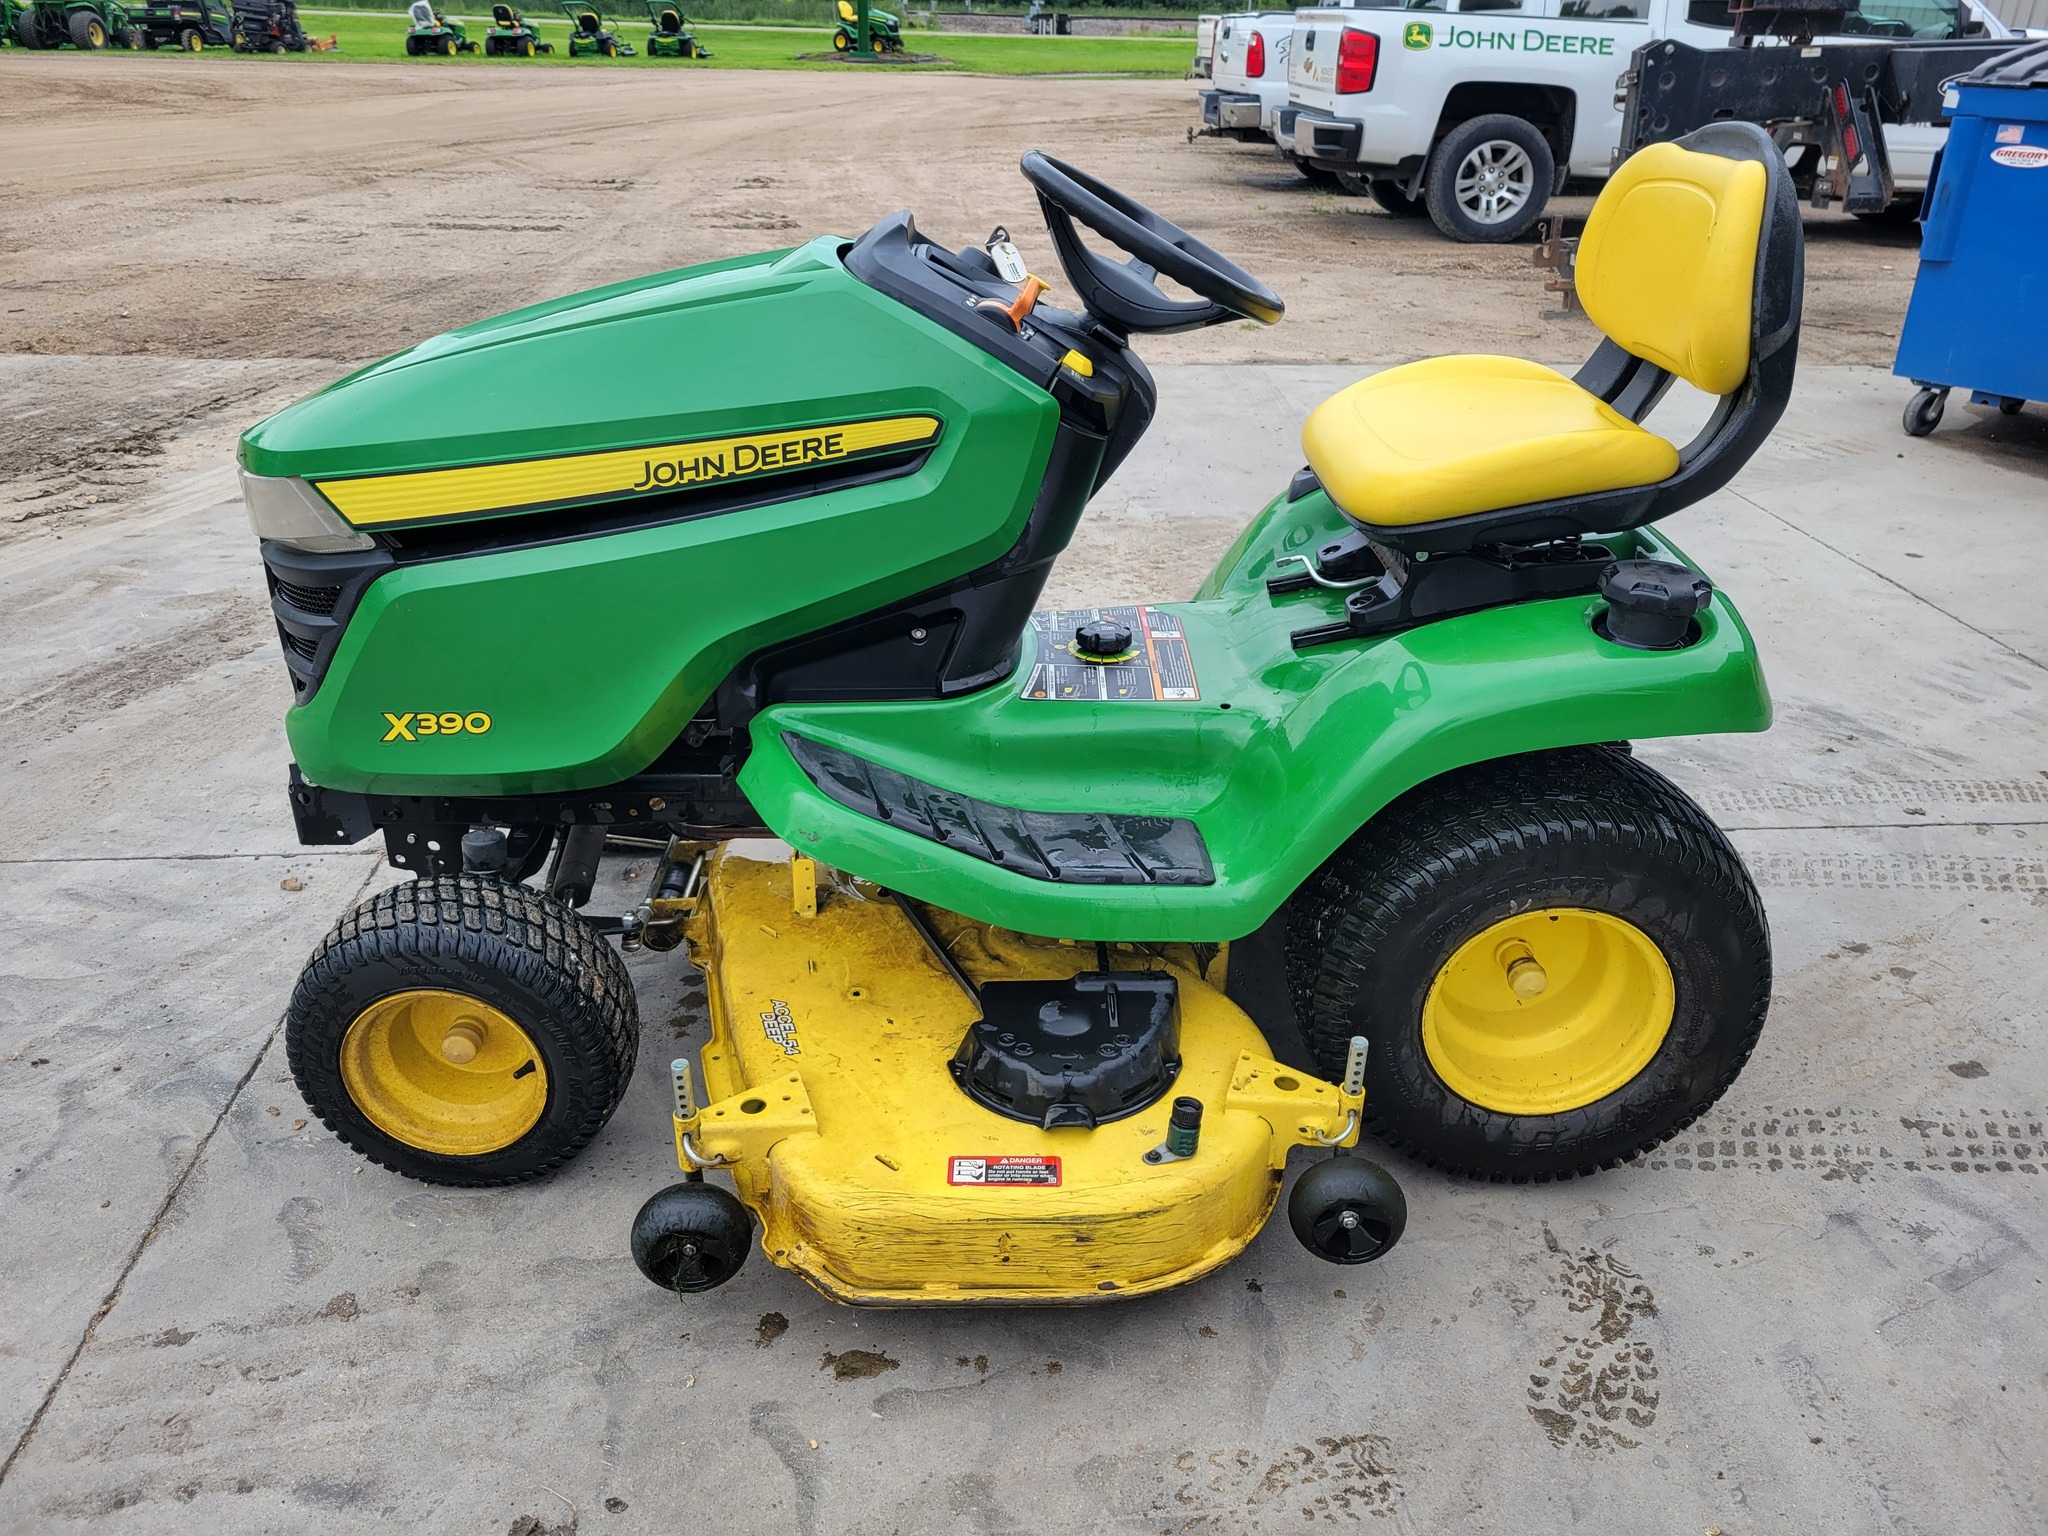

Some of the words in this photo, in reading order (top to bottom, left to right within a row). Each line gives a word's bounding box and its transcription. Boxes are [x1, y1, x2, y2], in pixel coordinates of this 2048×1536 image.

[1439, 26, 1515, 50] JOHN
[1523, 30, 1615, 56] DEERE
[1996, 150, 2048, 160] GREGORY
[633, 453, 725, 488] JOHN
[733, 433, 844, 471] DEERE
[379, 711, 492, 742] X390
[760, 1012, 783, 1044] DEEP
[770, 999, 797, 1039] ACCEL
[781, 1038, 801, 1055] 54
